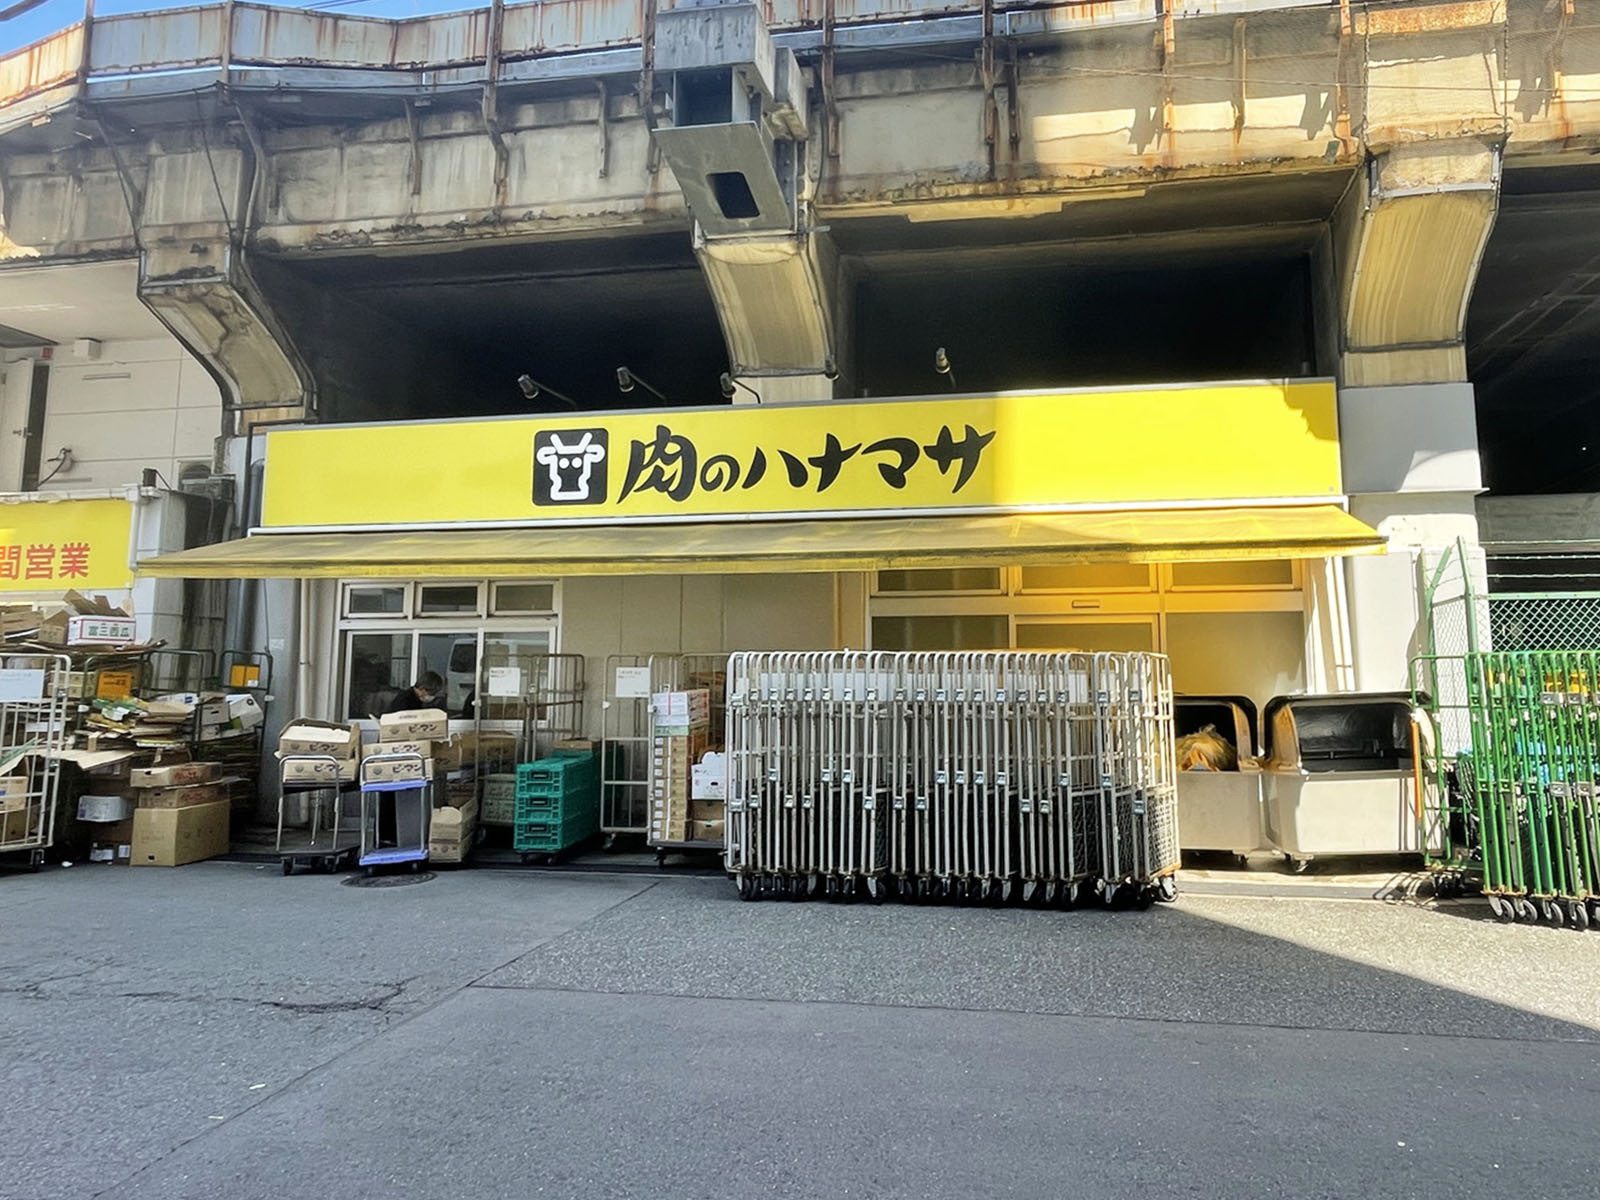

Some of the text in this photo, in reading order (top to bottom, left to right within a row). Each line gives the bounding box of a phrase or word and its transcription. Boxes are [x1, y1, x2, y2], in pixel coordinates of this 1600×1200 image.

[616, 424, 997, 504] 肉のハナマサ
[0, 542, 91, 580] 間営業
